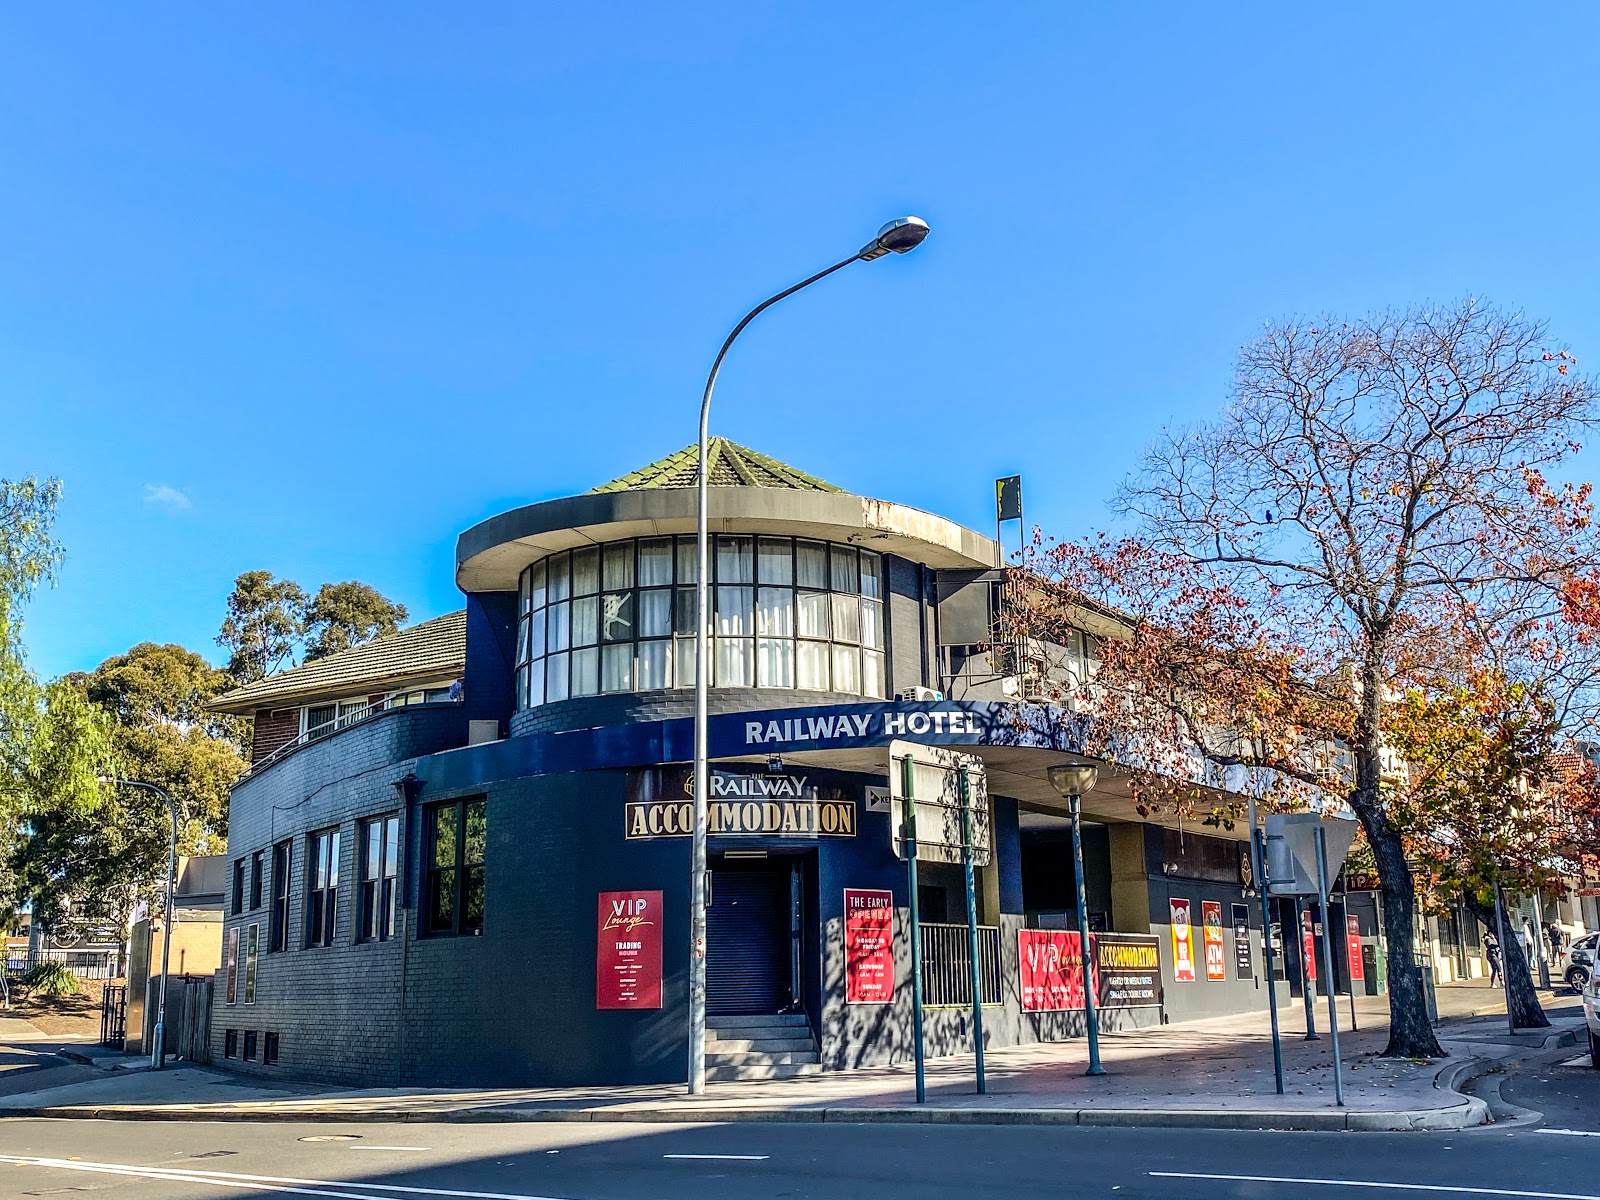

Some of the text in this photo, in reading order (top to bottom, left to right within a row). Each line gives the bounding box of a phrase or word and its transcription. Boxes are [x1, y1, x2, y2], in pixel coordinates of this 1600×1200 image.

[745, 711, 980, 744] RAILWAY HOTEL
[709, 775, 808, 797] RAILWAY
[631, 802, 852, 835] ACCOMMODATION
[612, 898, 647, 917] VIP
[850, 896, 889, 909] THE EARLY
[602, 911, 654, 933] Lounge
[615, 942, 642, 950] TRADING
[1100, 945, 1158, 968] ACCOMMODATION
[1208, 944, 1223, 963] ATM
[1027, 943, 1058, 973] VIP
